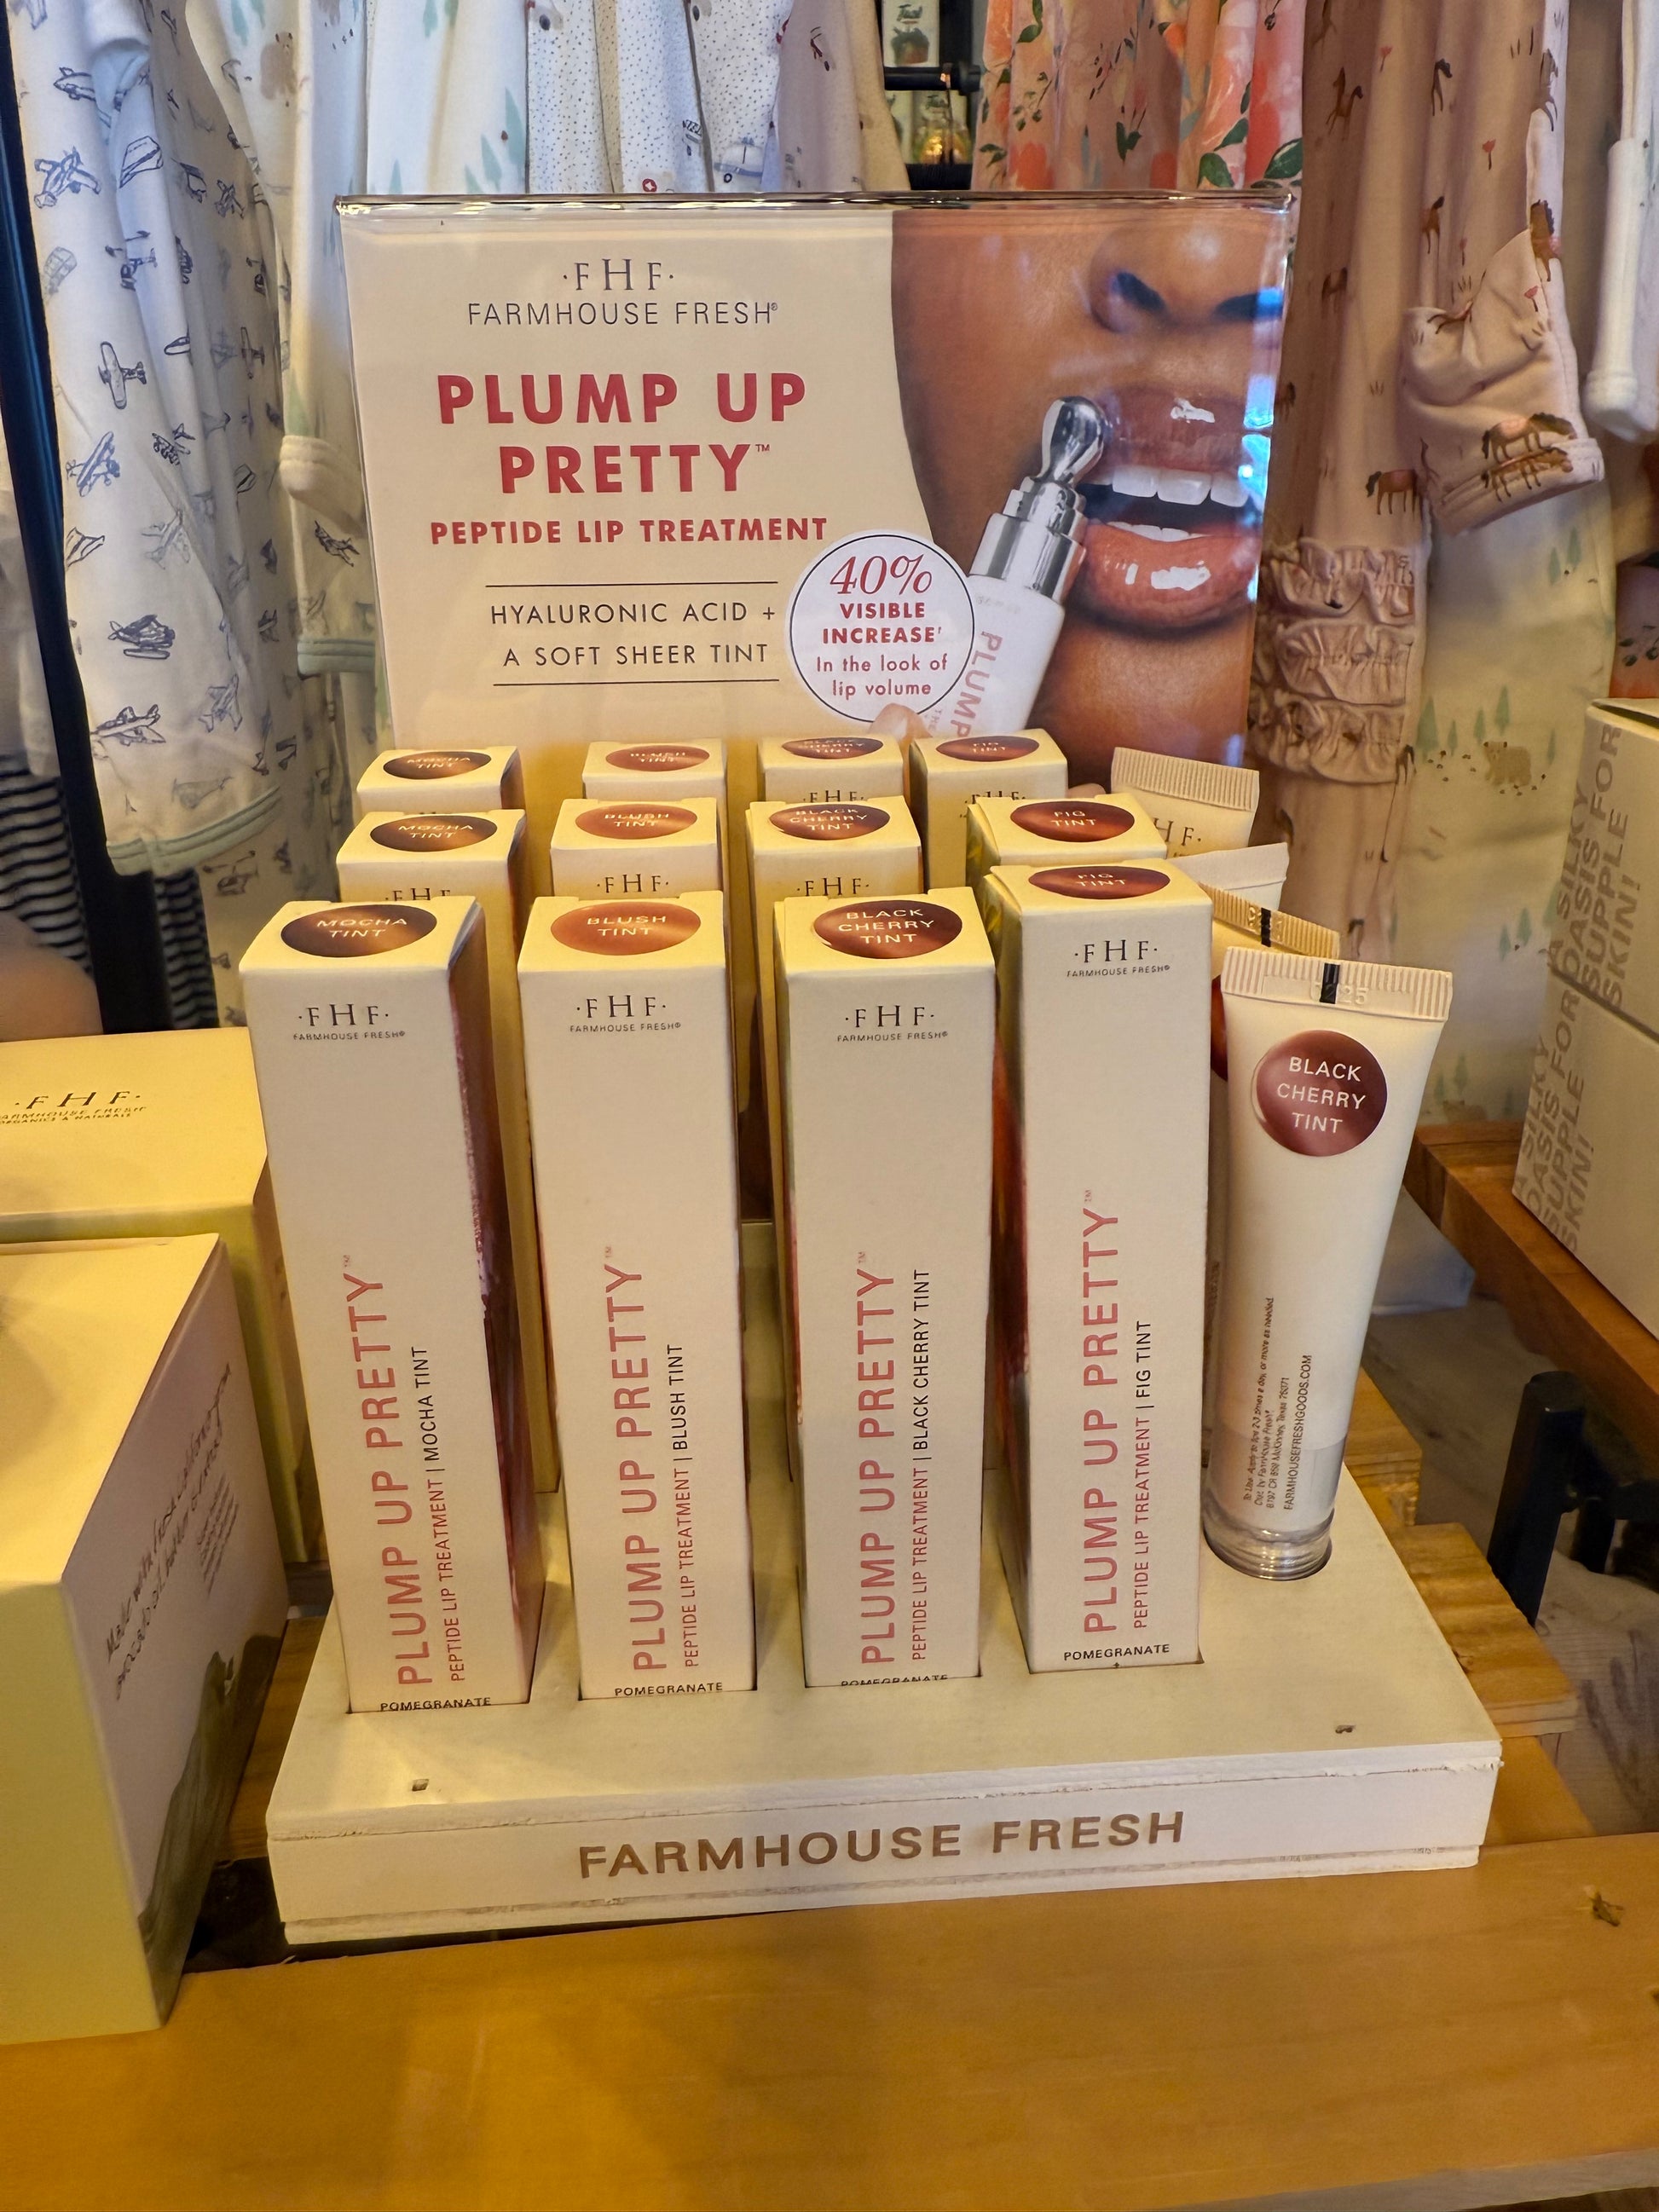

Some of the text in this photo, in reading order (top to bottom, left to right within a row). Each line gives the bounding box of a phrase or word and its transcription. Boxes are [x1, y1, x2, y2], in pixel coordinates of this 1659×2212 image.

[468, 302, 658, 326] FARMHOUSE
[437, 373, 806, 424] PLUMP UP
[431, 517, 827, 546] PEPTIDE LIP TREATMENT
[830, 553, 933, 596] 40%
[491, 603, 668, 625] HYALURONIC
[682, 602, 749, 623] ACID
[839, 602, 926, 620] VISIBLE
[503, 642, 769, 667] A SOFT SHEER TINT
[816, 653, 948, 673] In the look of
[832, 679, 932, 700] lip volume
[951, 631, 1003, 737] PLUMP
[789, 814, 868, 823] CHERRY
[806, 823, 853, 831] TINT
[1050, 818, 1096, 827] TINT
[1564, 725, 1621, 979] OASIS FOR
[1075, 879, 1126, 887] TINT
[1581, 809, 1628, 992] SUPPLE
[316, 918, 408, 927] MOCHA
[587, 915, 667, 925] BLUSH
[838, 920, 934, 932] CHERRY
[846, 909, 924, 920] BLACK
[328, 929, 386, 938] TINT
[597, 927, 654, 936] TINT
[859, 933, 917, 944] TINT
[1603, 875, 1640, 1006] SKIN!
[1066, 967, 1128, 978] FARMHOUSE
[293, 1032, 358, 1041] FARMHOUSE
[569, 1024, 635, 1032] FARMHOUSE
[837, 1033, 902, 1042] FARMHOUSE
[1551, 990, 1581, 1078] FOR
[1289, 1056, 1362, 1083] BLACK
[1277, 1083, 1366, 1110] CHERRY
[0, 1110, 87, 1119] ARMHOUSE
[1292, 1112, 1343, 1134] TINT
[1544, 1071, 1584, 1234] SUPPLE
[1562, 1135, 1594, 1250] SKIN!
[1084, 1409, 1118, 1465] UP
[1284, 1355, 1312, 1510] FARMHOUSEFRESHGOODS.COM
[912, 1269, 930, 1660] PEPTIDE LIP TREATMENT BLACK CHERRY TINT
[1134, 1321, 1152, 1628] PEPTIDE LIP TREATMENT FIG TINT
[372, 1470, 413, 1526] UP
[620, 1459, 657, 1514] UP
[859, 1459, 895, 1513] UP
[411, 1346, 466, 1683] PEPTIDE LIP TREATMENT MOCHA TINT
[668, 1344, 700, 1667] PEPTIDE LIP TREATMENT BLUSH TINT
[1084, 1487, 1118, 1633] PLUMP
[625, 1534, 667, 1672] PLUMP
[860, 1532, 895, 1664] PLUMP
[382, 1545, 433, 1687] PLUMP
[1064, 1644, 1170, 1660] POMEGRANATE
[615, 1682, 723, 1696] POMEGRANATE
[380, 1697, 491, 1712] POMEGRANATE
[579, 1811, 1183, 1878] FARMHOUSE FRESH
